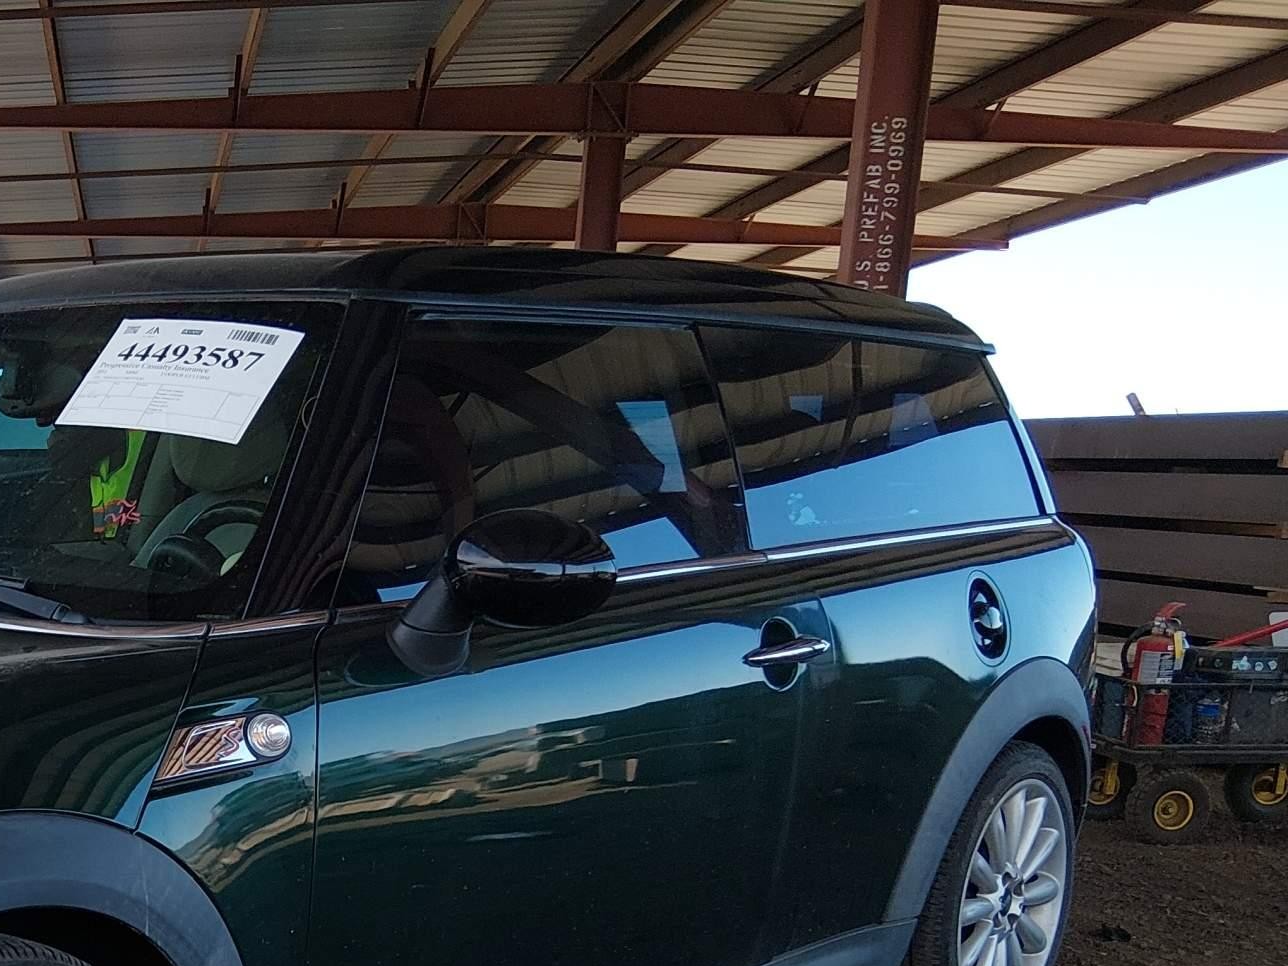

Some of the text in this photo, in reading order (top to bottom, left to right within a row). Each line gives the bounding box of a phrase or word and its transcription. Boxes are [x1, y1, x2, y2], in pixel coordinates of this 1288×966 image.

[869, 115, 889, 153] INC.
[859, 164, 882, 242] PREFAB
[873, 117, 907, 290] 1-866-799-0969
[118, 342, 265, 371] 44493587
